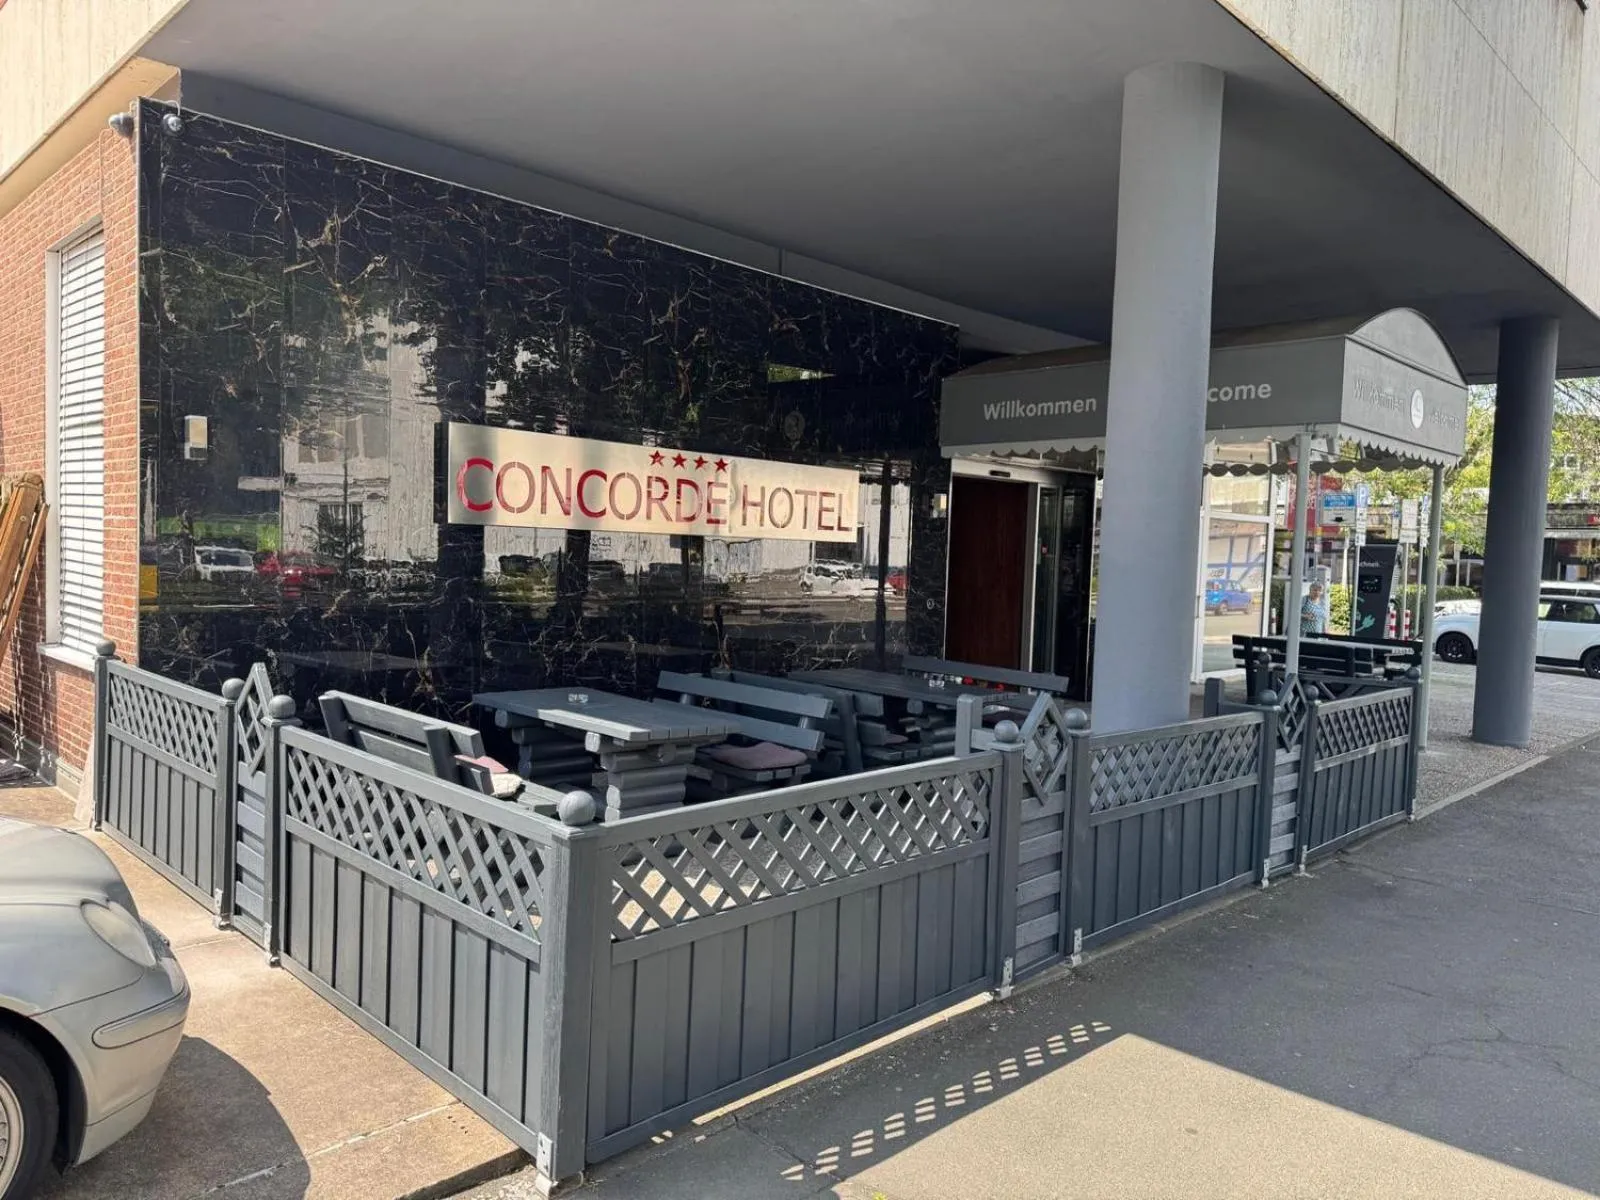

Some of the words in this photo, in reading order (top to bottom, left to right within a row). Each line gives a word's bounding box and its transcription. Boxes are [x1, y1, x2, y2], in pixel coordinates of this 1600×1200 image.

[983, 397, 1097, 420] Willkommen
[1208, 383, 1272, 402] come
[456, 457, 727, 525] CONCORDE
[742, 484, 852, 532] HOTEL
